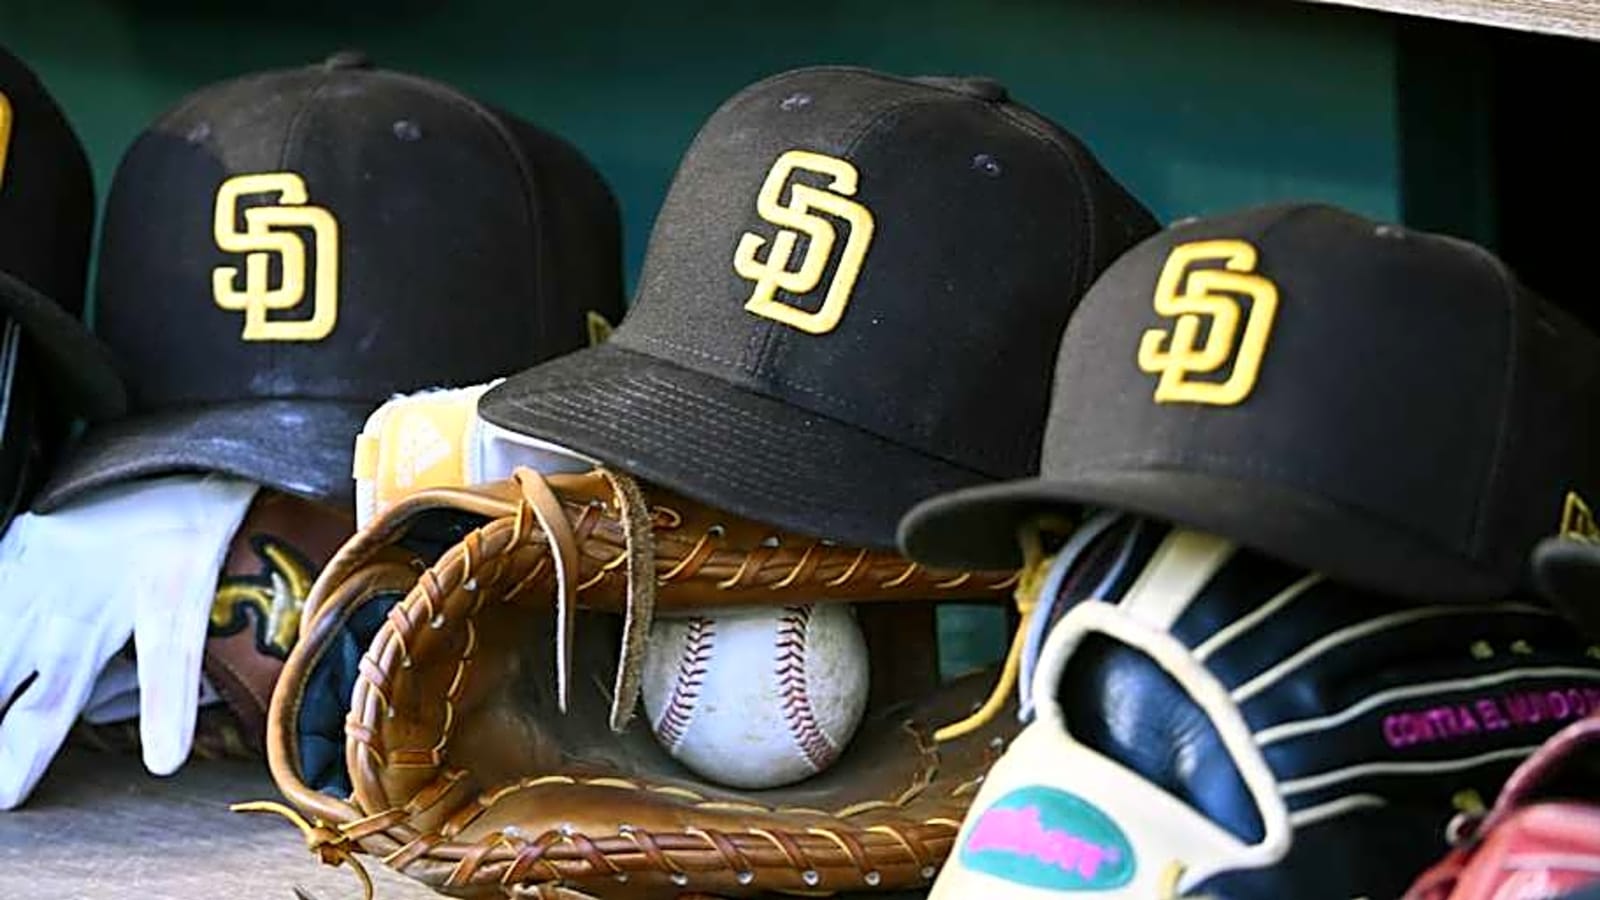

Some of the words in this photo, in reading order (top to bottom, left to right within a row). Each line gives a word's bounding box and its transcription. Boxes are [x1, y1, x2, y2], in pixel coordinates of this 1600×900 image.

[212, 172, 340, 341] SD
[733, 150, 876, 335] SD
[1137, 239, 1279, 406] SD
